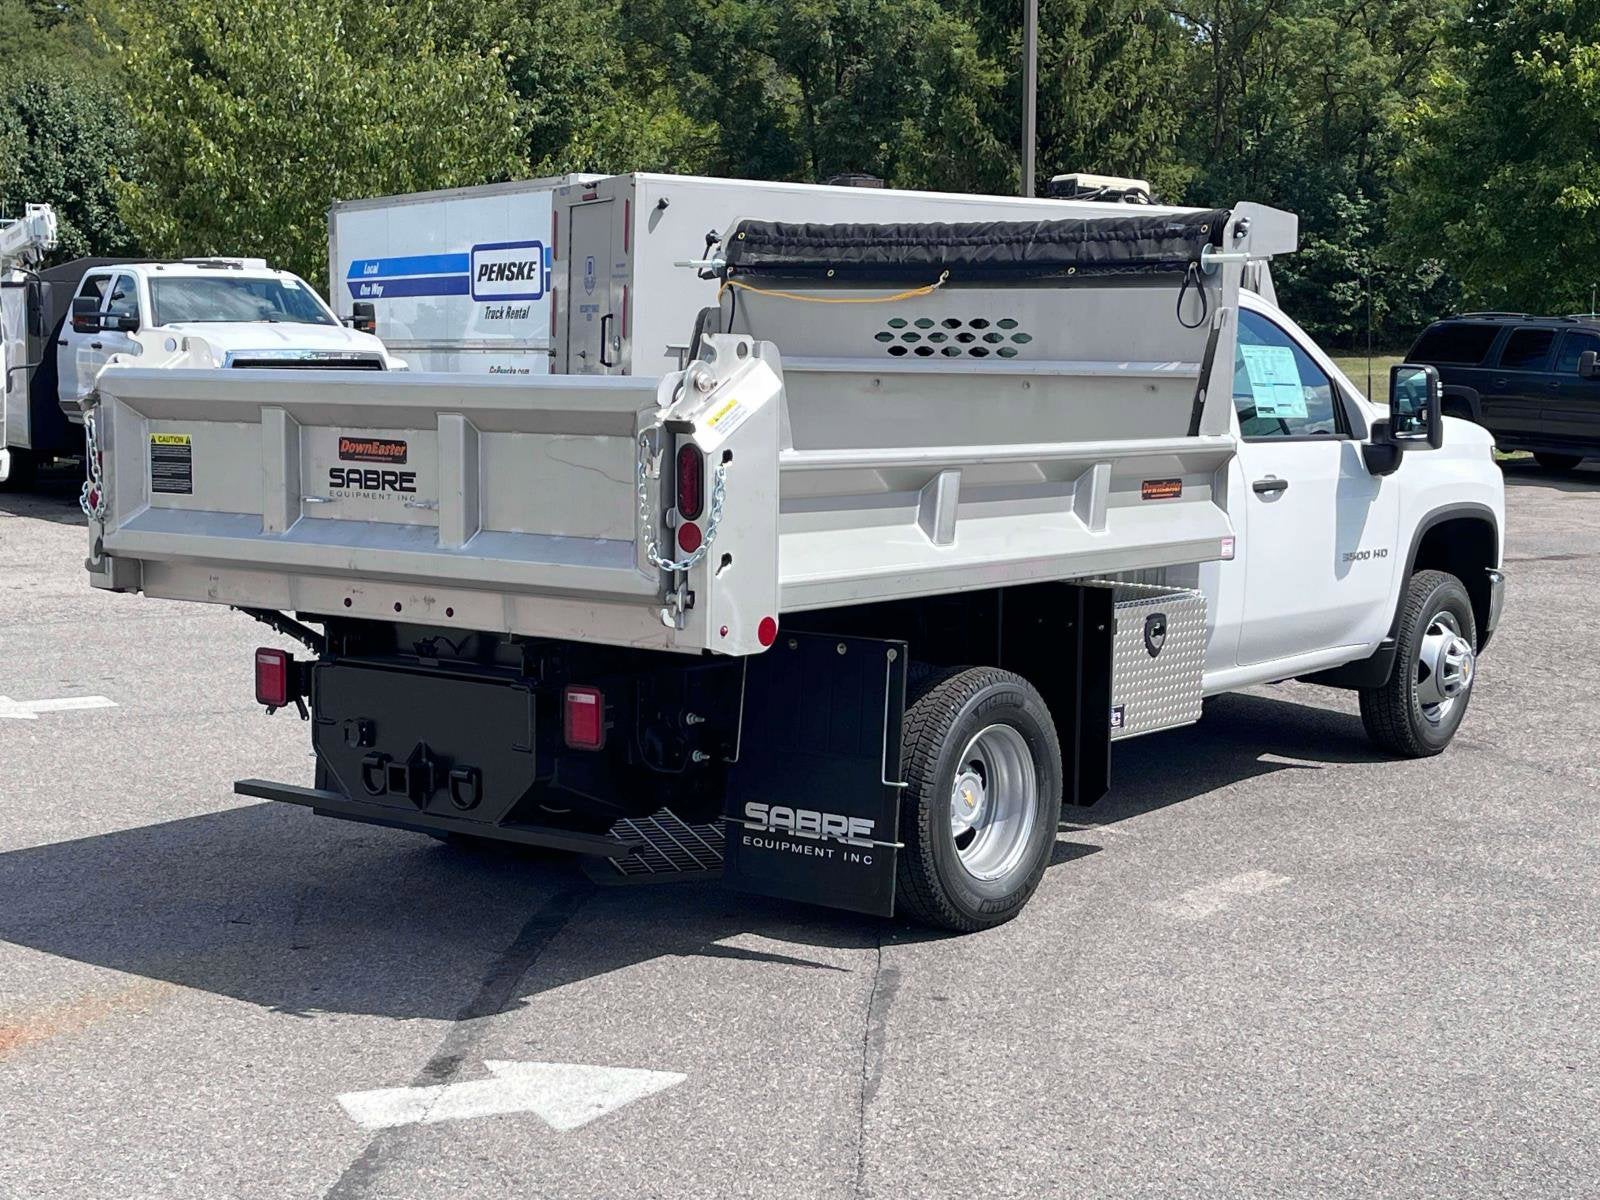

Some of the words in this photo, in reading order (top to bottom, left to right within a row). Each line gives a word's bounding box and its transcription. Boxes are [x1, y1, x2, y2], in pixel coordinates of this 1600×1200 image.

[363, 261, 380, 274] Local
[477, 260, 538, 282] PENSKE
[359, 283, 371, 296] One
[370, 283, 384, 298] Way
[484, 306, 504, 320] Truck
[505, 305, 530, 320] Rental
[157, 434, 184, 444] CAUTION
[340, 439, 407, 456] DownEaster
[328, 467, 417, 493] SABRE
[329, 489, 392, 500] EQUIPMENT
[396, 494, 416, 503] INC
[1342, 550, 1371, 562] 3500
[1373, 548, 1389, 559] HD
[743, 801, 875, 848] SABRE
[742, 835, 836, 859] EQUIPMENT
[843, 851, 874, 866] INC
